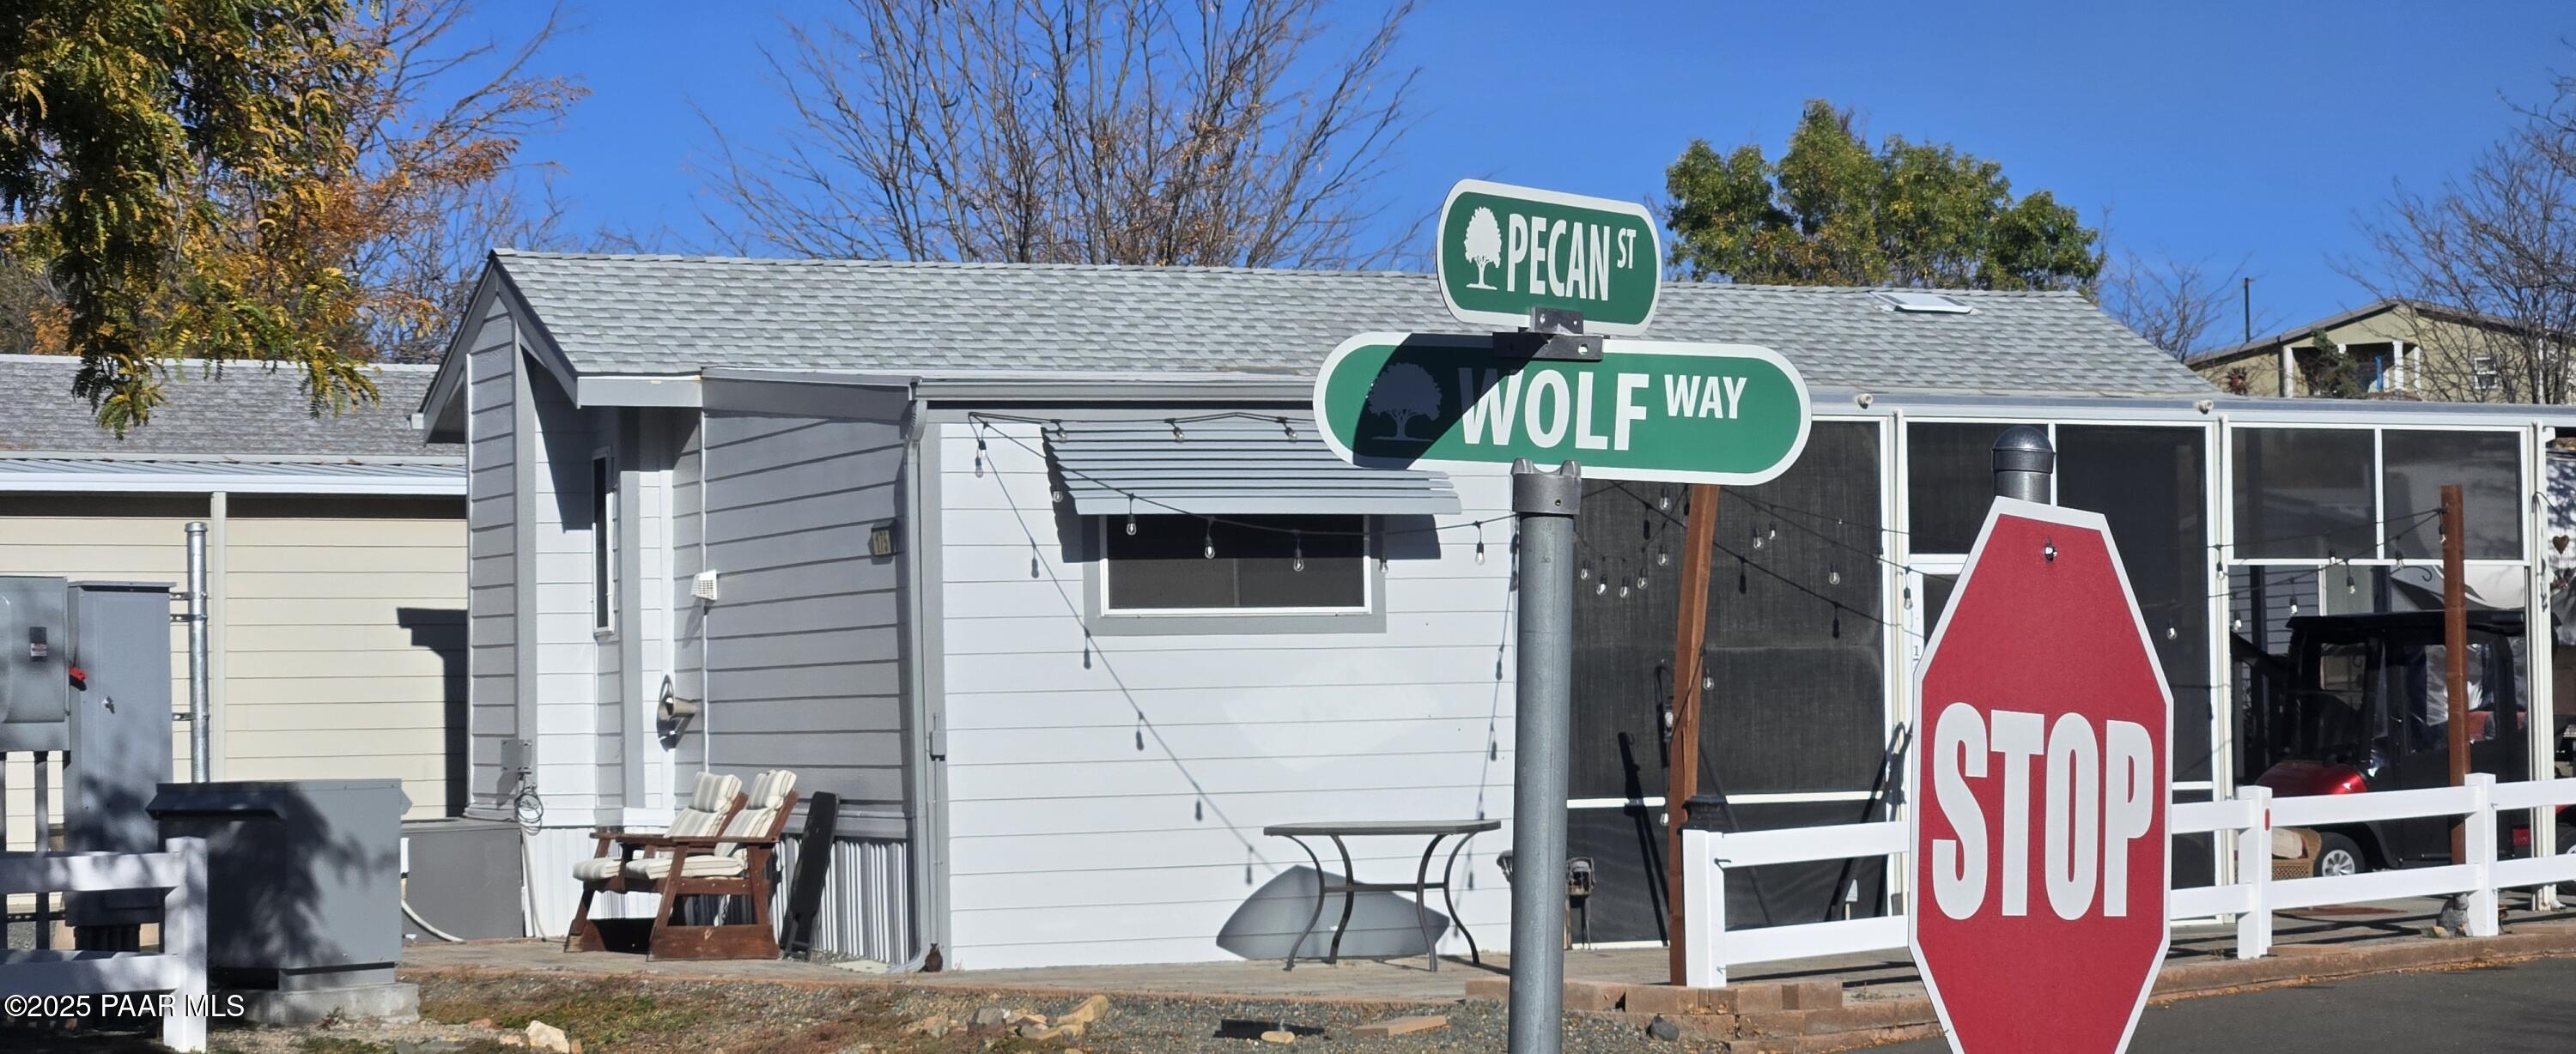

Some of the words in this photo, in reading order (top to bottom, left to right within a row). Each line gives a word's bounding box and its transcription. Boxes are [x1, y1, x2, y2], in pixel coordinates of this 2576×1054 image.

[1506, 212, 1611, 301] PECAN
[1616, 228, 1637, 270] ST
[1457, 366, 1650, 451] WOLF
[1663, 373, 1748, 420] WAY
[1932, 702, 2154, 921] STOP
